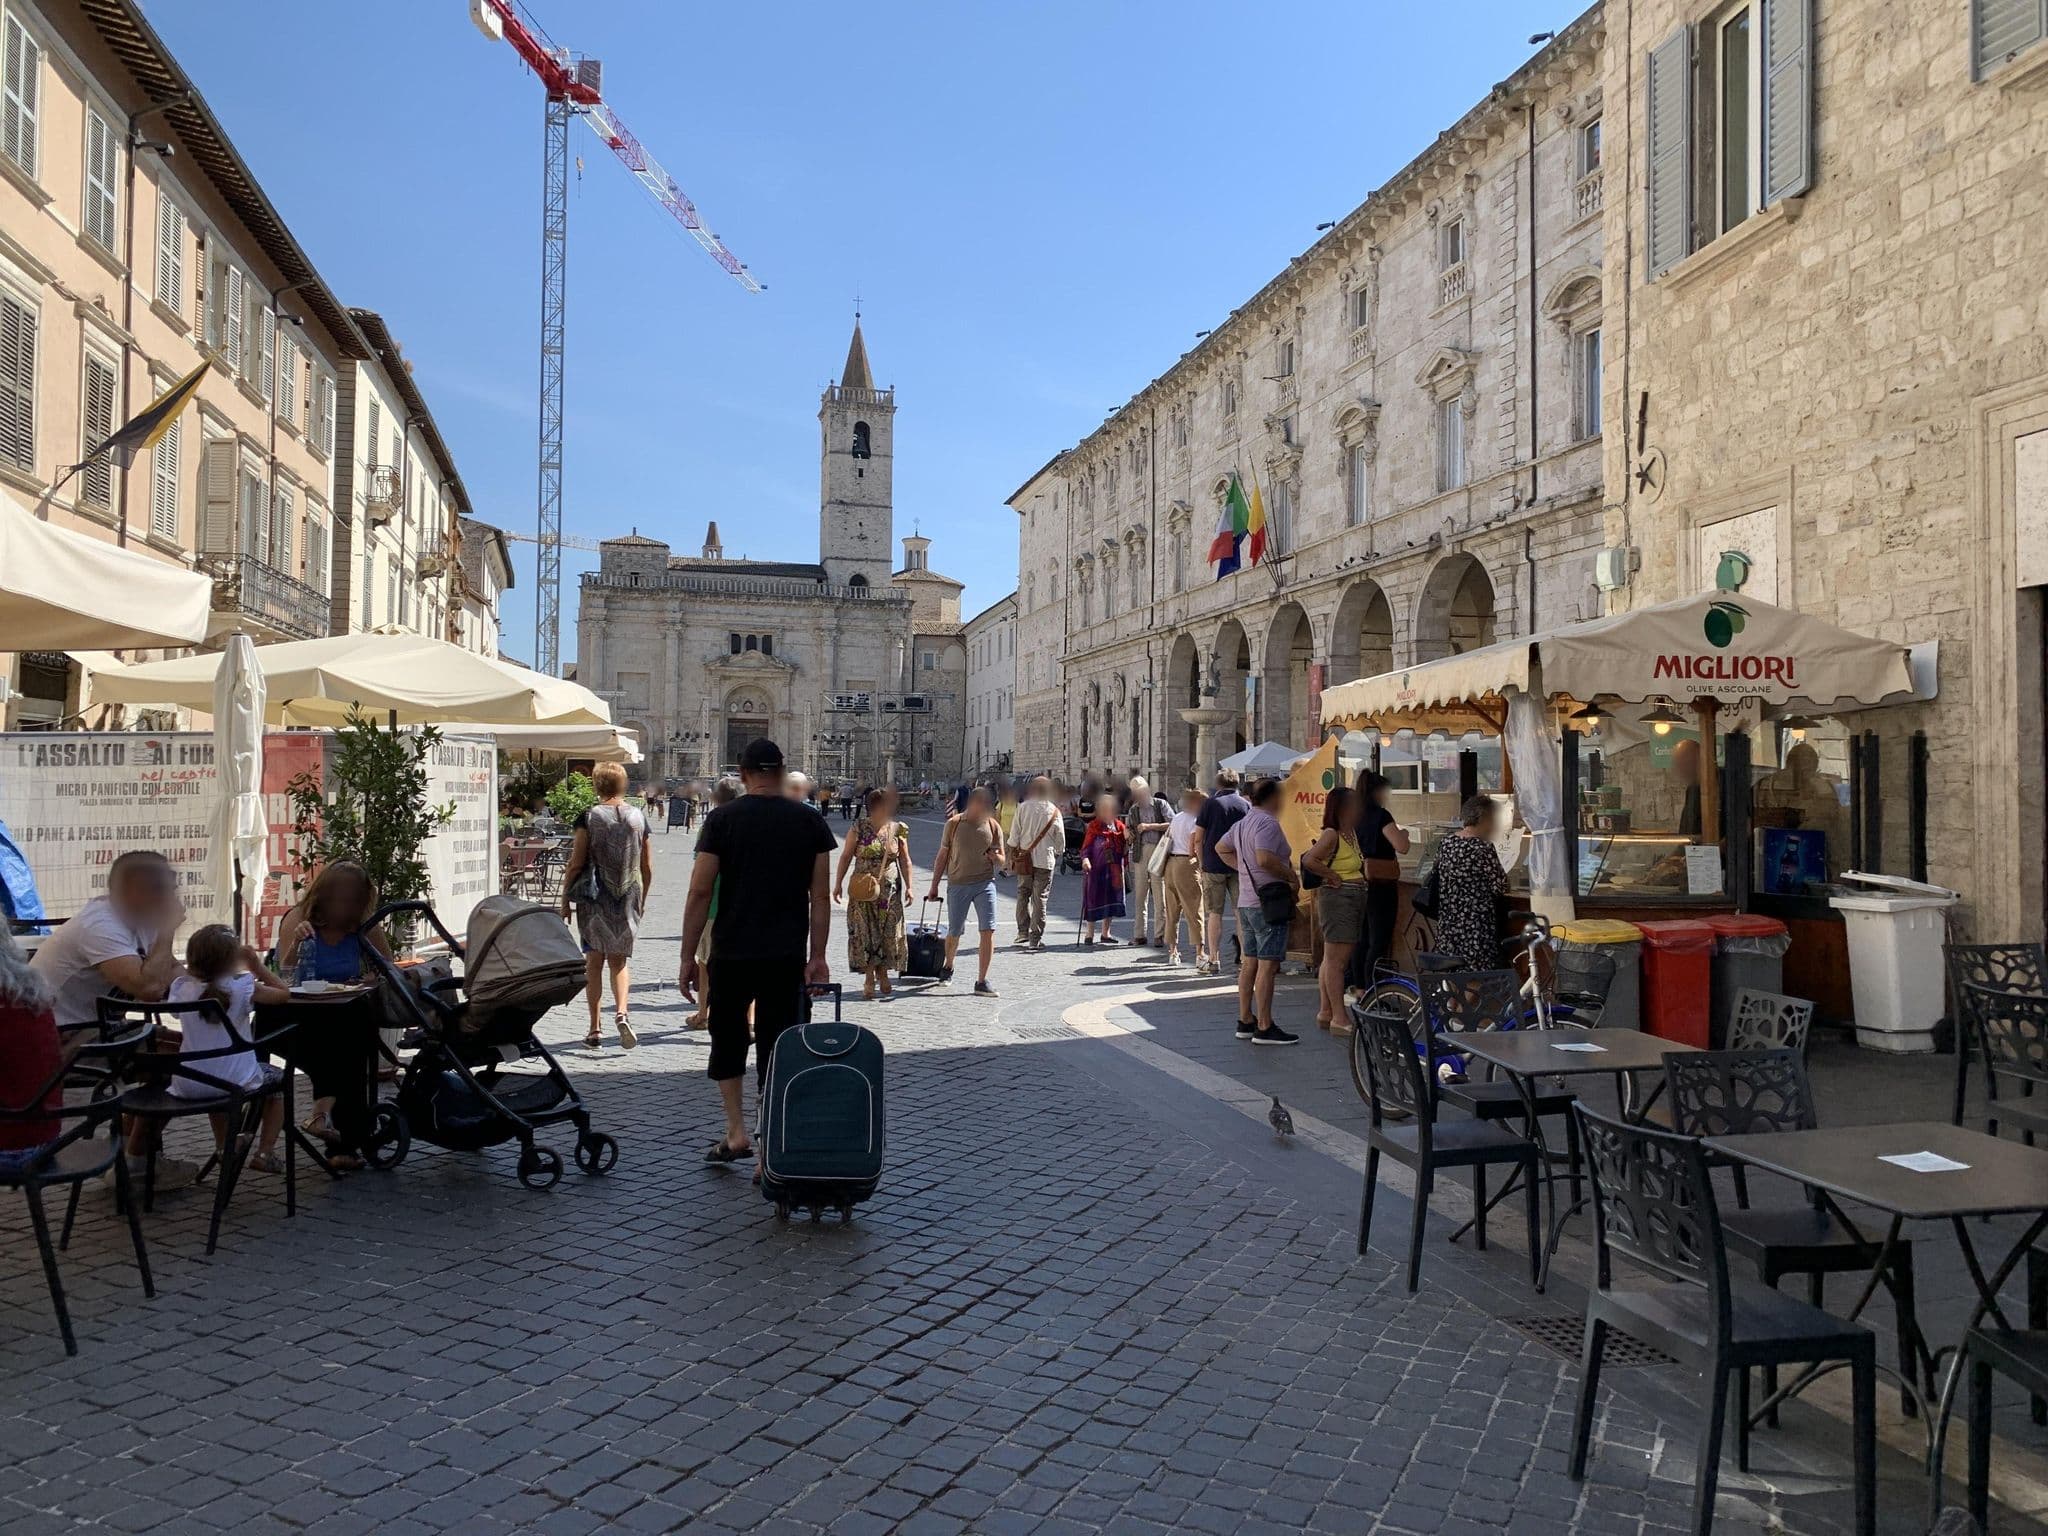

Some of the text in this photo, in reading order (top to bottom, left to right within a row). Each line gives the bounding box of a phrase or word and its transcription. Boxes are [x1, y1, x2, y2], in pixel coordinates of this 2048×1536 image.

[1653, 655, 1801, 689] MIGLIORI
[1686, 685, 1772, 694] OLIVE ASCOLANE
[18, 743, 125, 767] L'ASSALTO
[56, 783, 88, 796] MICRO
[91, 782, 138, 796] PANIFICIO
[67, 827, 75, 841] A
[78, 827, 113, 841] PASTA
[159, 825, 181, 840] CON
